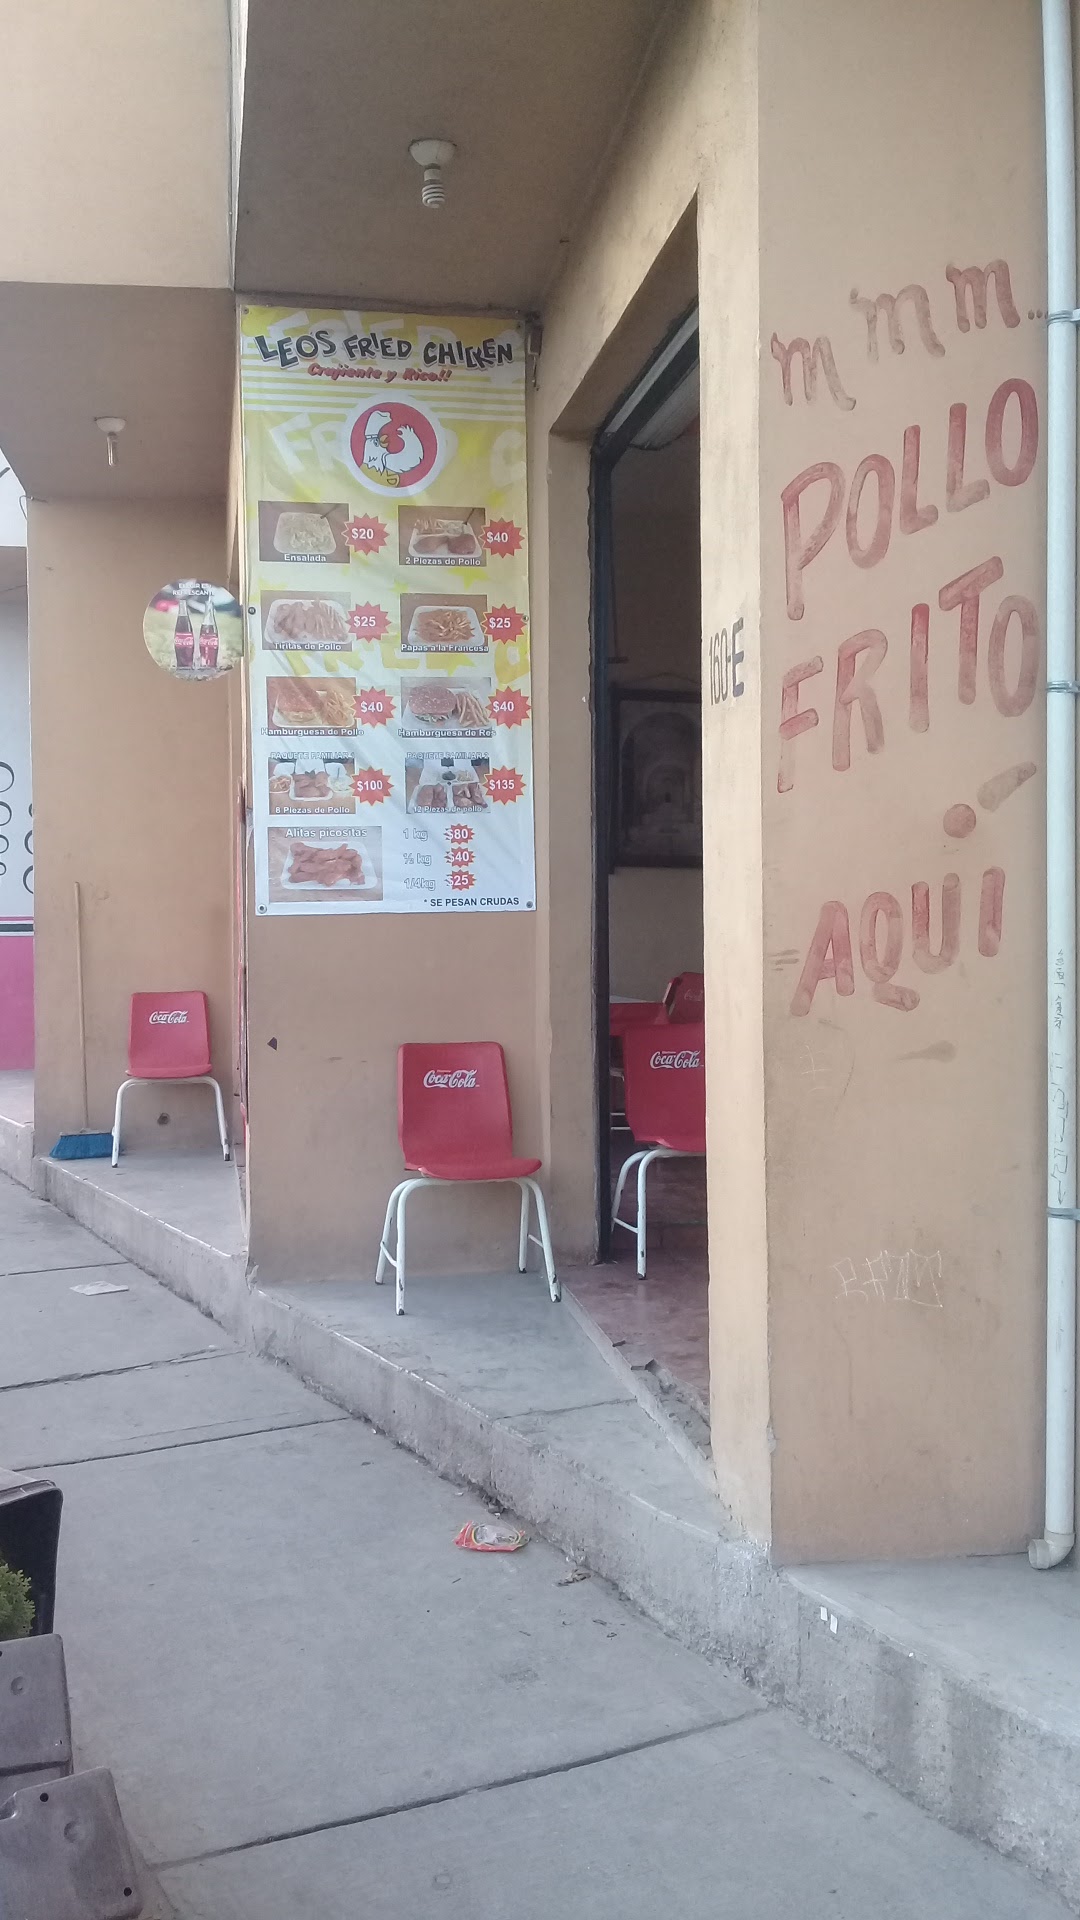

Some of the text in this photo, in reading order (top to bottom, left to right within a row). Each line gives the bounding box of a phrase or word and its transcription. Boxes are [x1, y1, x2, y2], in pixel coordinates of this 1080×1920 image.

[343, 332, 412, 361] FRIED
[423, 338, 514, 370] CHICKEN
[384, 369, 397, 383] y
[780, 377, 1040, 621] POLLO
[351, 528, 374, 541] $20
[486, 531, 509, 543] $40
[284, 553, 327, 562] Ensalada
[405, 556, 411, 565] 2
[445, 557, 456, 566] de
[458, 557, 481, 566] Pollo
[353, 616, 376, 628] $25
[488, 617, 511, 629] $25
[274, 642, 342, 651] Tiritas de Pollo
[401, 643, 428, 652] Papas
[448, 644, 489, 652] Francesa
[708, 616, 745, 706] 160-E
[776, 555, 1040, 794] FRITO
[360, 701, 383, 713] $40
[492, 701, 515, 713] $40
[260, 728, 364, 737] Hamburguesa de Pollo
[397, 728, 497, 738] Hamburguesa de Res
[356, 779, 383, 792] $100
[488, 778, 515, 791] $135
[275, 806, 350, 814] 8 Piezas de Pollo
[285, 827, 368, 840] Alitas picositas
[403, 828, 429, 842] 1 kg
[445, 829, 469, 840] $80
[416, 853, 432, 867] kg
[446, 851, 470, 863] $40
[446, 874, 469, 886] $25
[430, 897, 520, 907] SE PESAN CRUDAS
